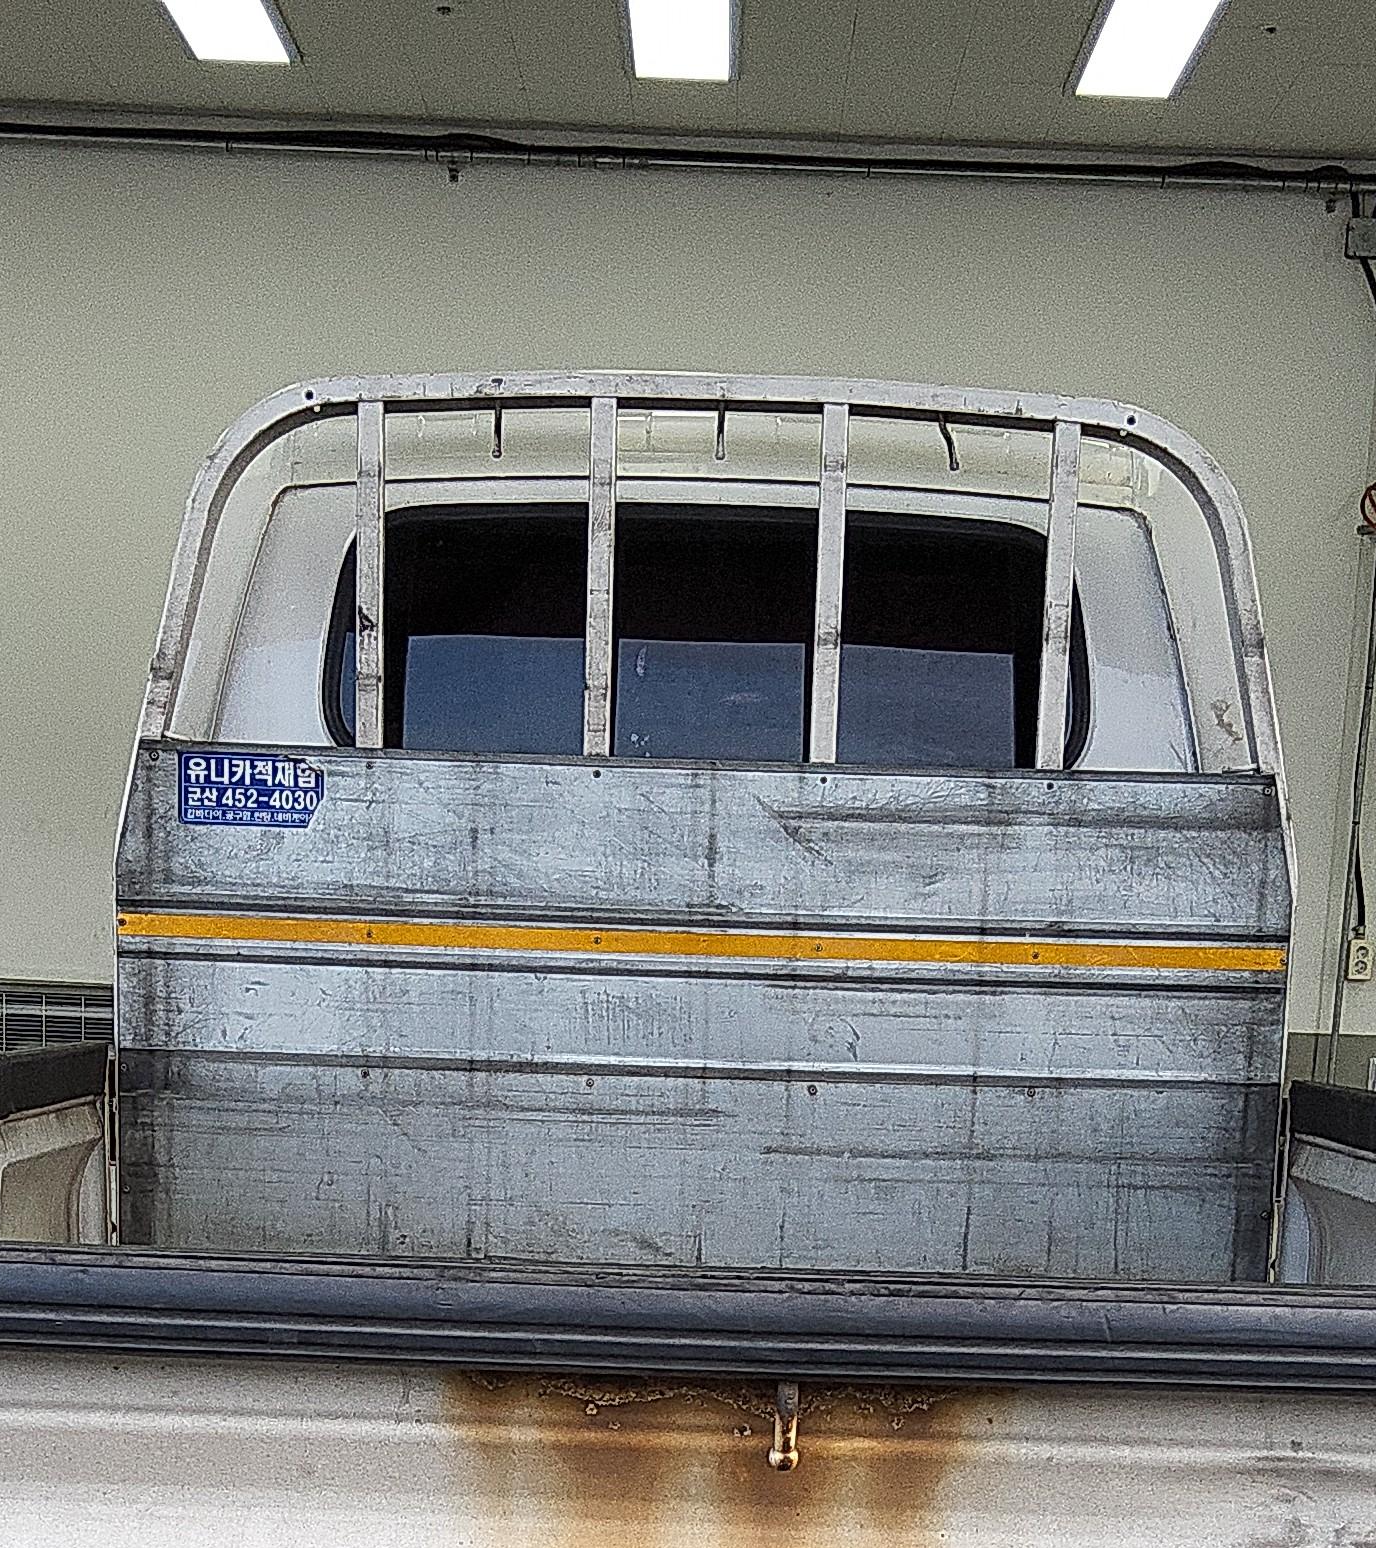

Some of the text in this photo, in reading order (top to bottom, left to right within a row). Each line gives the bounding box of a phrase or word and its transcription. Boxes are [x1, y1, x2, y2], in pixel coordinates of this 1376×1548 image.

[186, 757, 316, 788] 유니카적재함
[187, 787, 318, 811] 군산 452-4030
